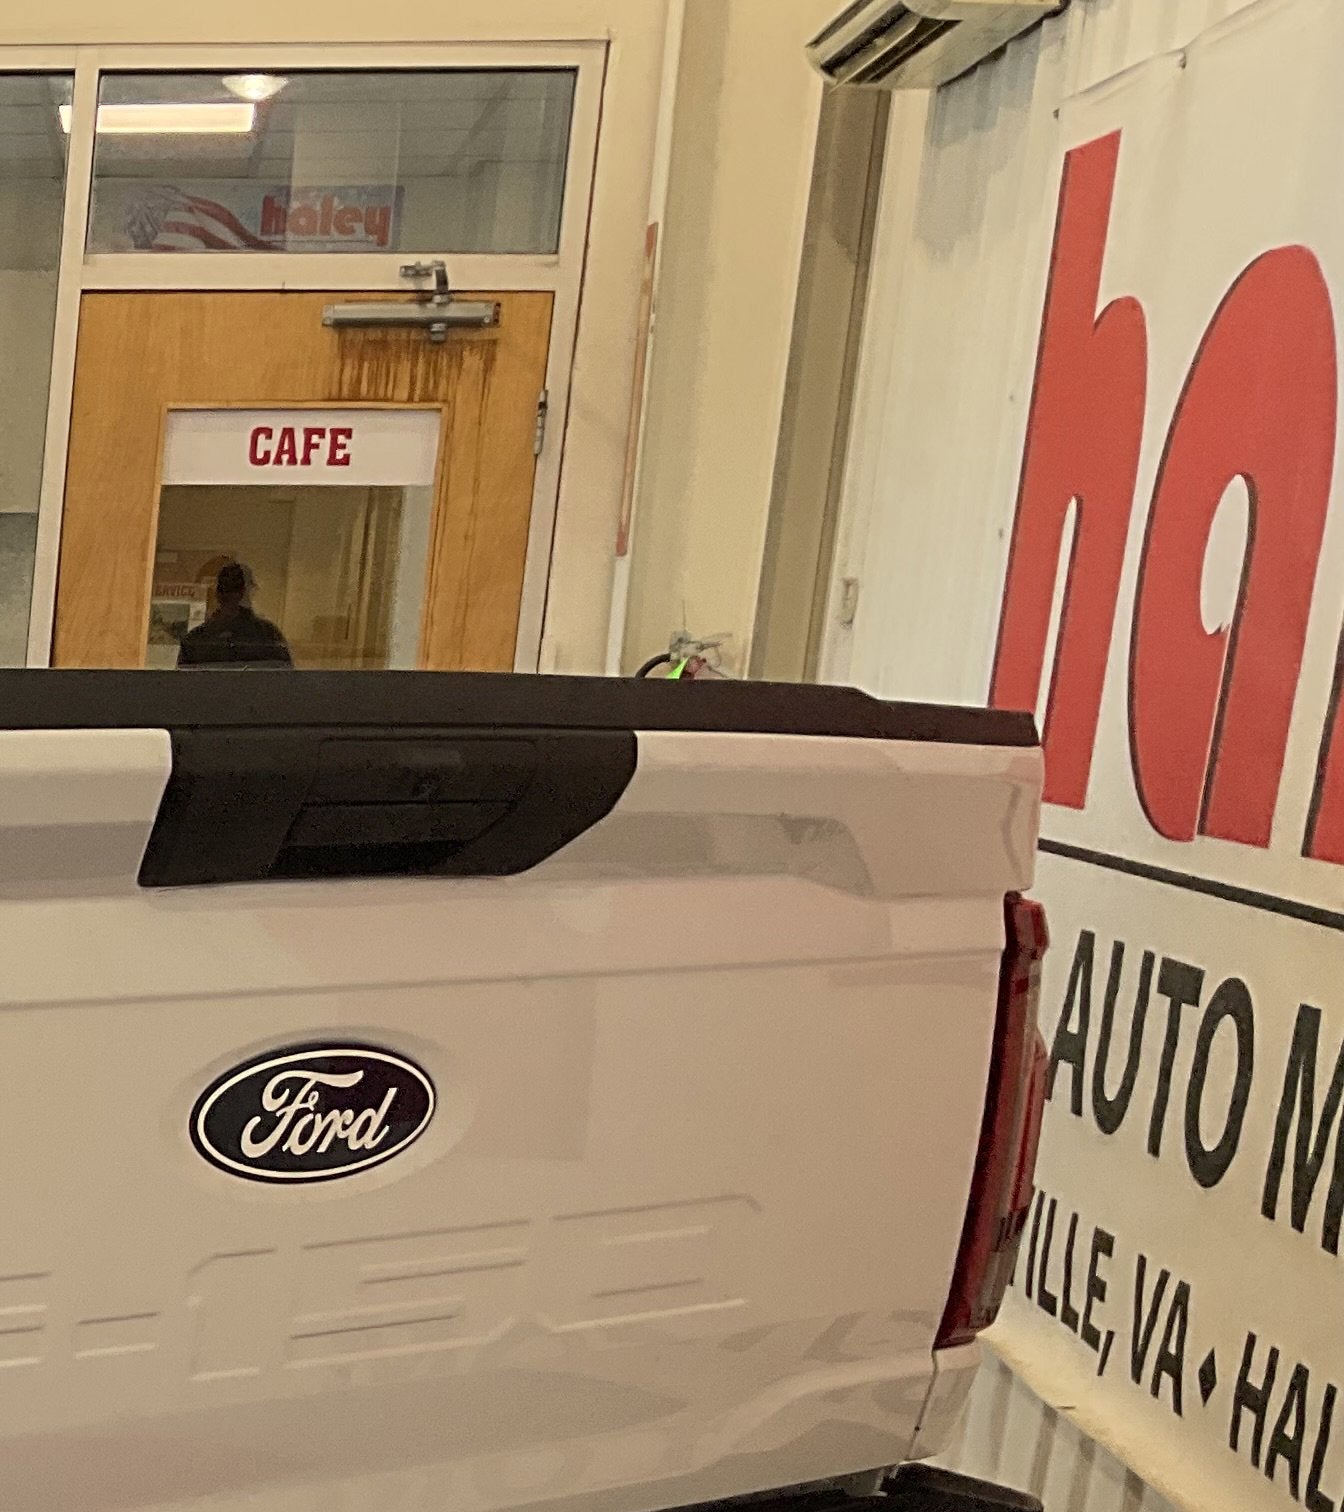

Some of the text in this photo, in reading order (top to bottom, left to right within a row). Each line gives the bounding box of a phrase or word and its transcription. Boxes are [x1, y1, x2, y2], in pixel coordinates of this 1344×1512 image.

[260, 193, 393, 247] haley
[248, 426, 353, 466] CAFE
[153, 584, 196, 598] ERVICE
[1045, 929, 1255, 1189] AUTO
[240, 1069, 398, 1159] Ford
[1011, 1187, 1115, 1377] ILLE,
[1130, 1253, 1191, 1418] VA
